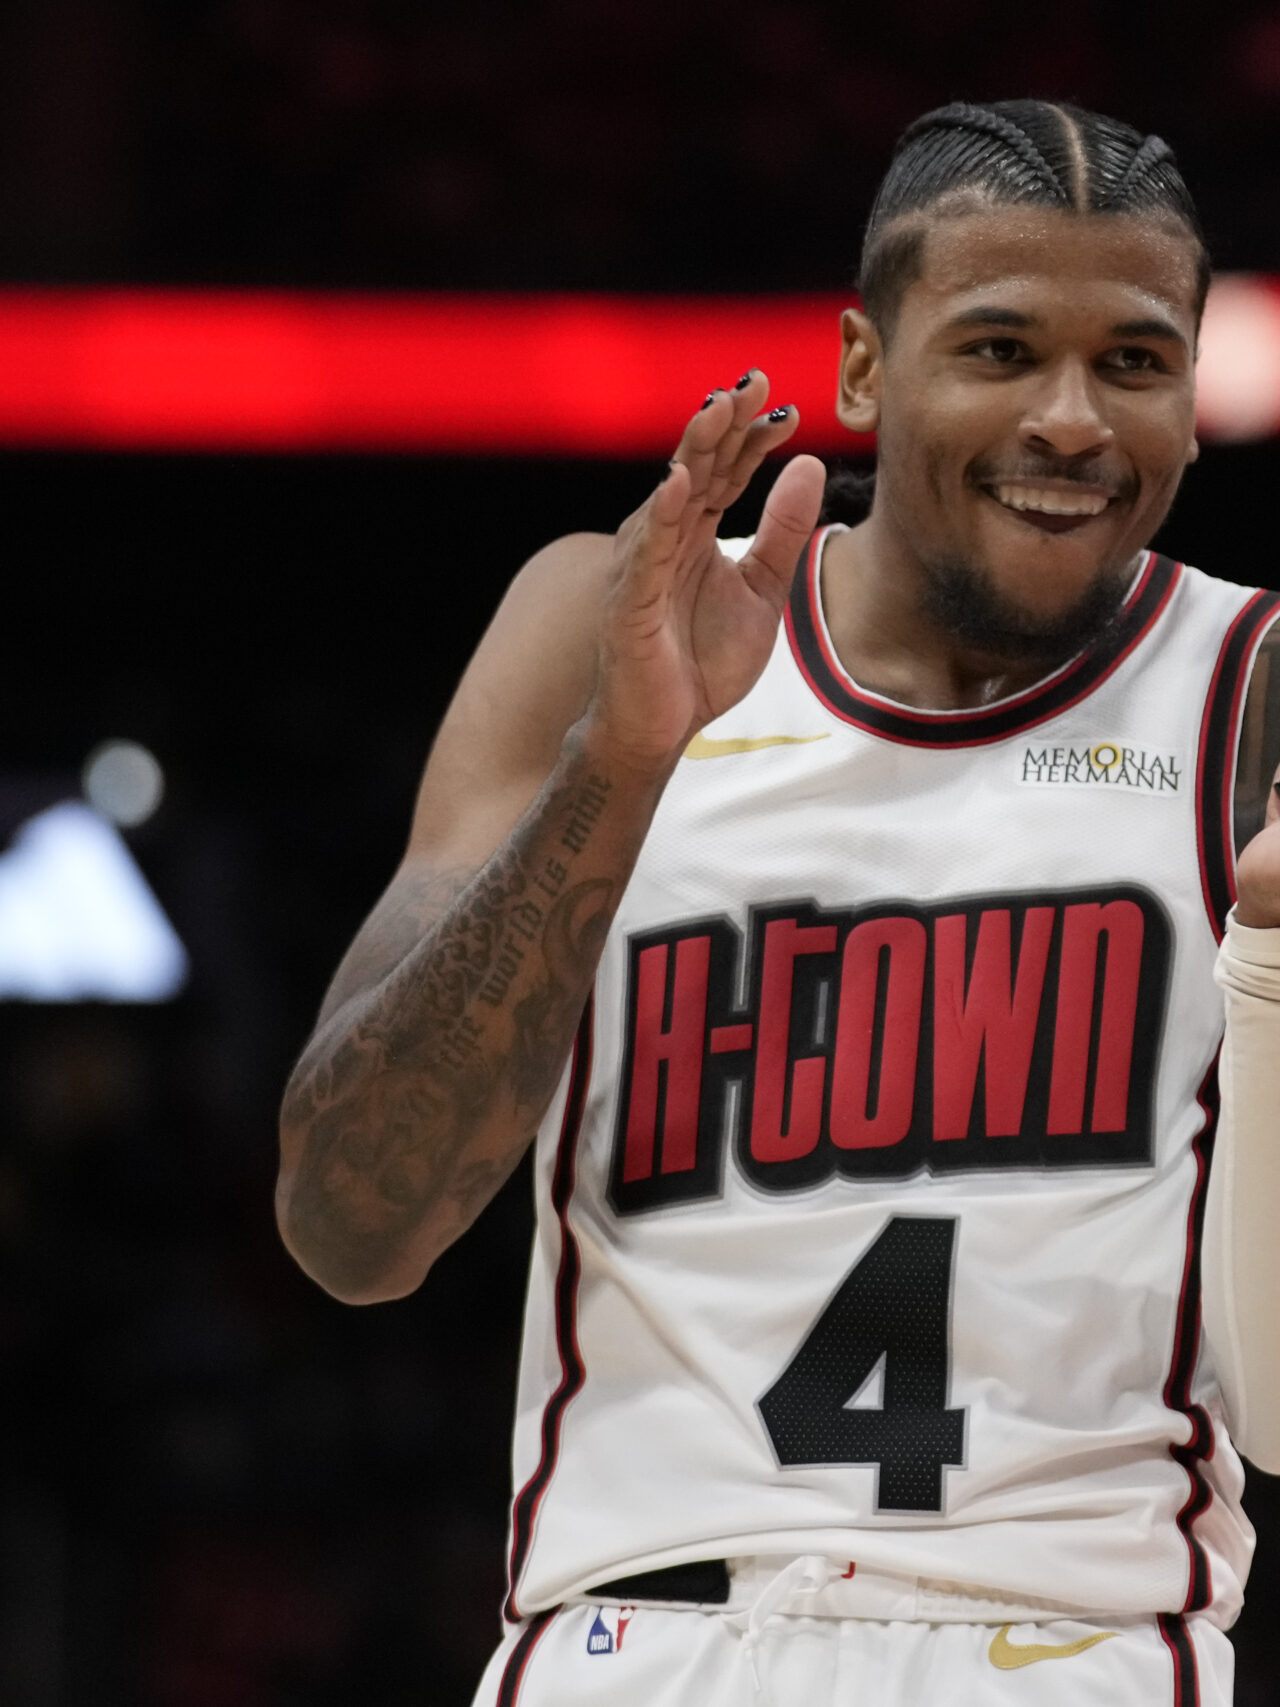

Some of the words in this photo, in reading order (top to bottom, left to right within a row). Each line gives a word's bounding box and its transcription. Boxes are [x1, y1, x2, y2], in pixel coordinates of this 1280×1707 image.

[1023, 743, 1182, 775] MEMORIAL
[1021, 762, 1181, 791] HERMANN
[755, 1214, 968, 1515] 4
[590, 1634, 610, 1651] NBA
